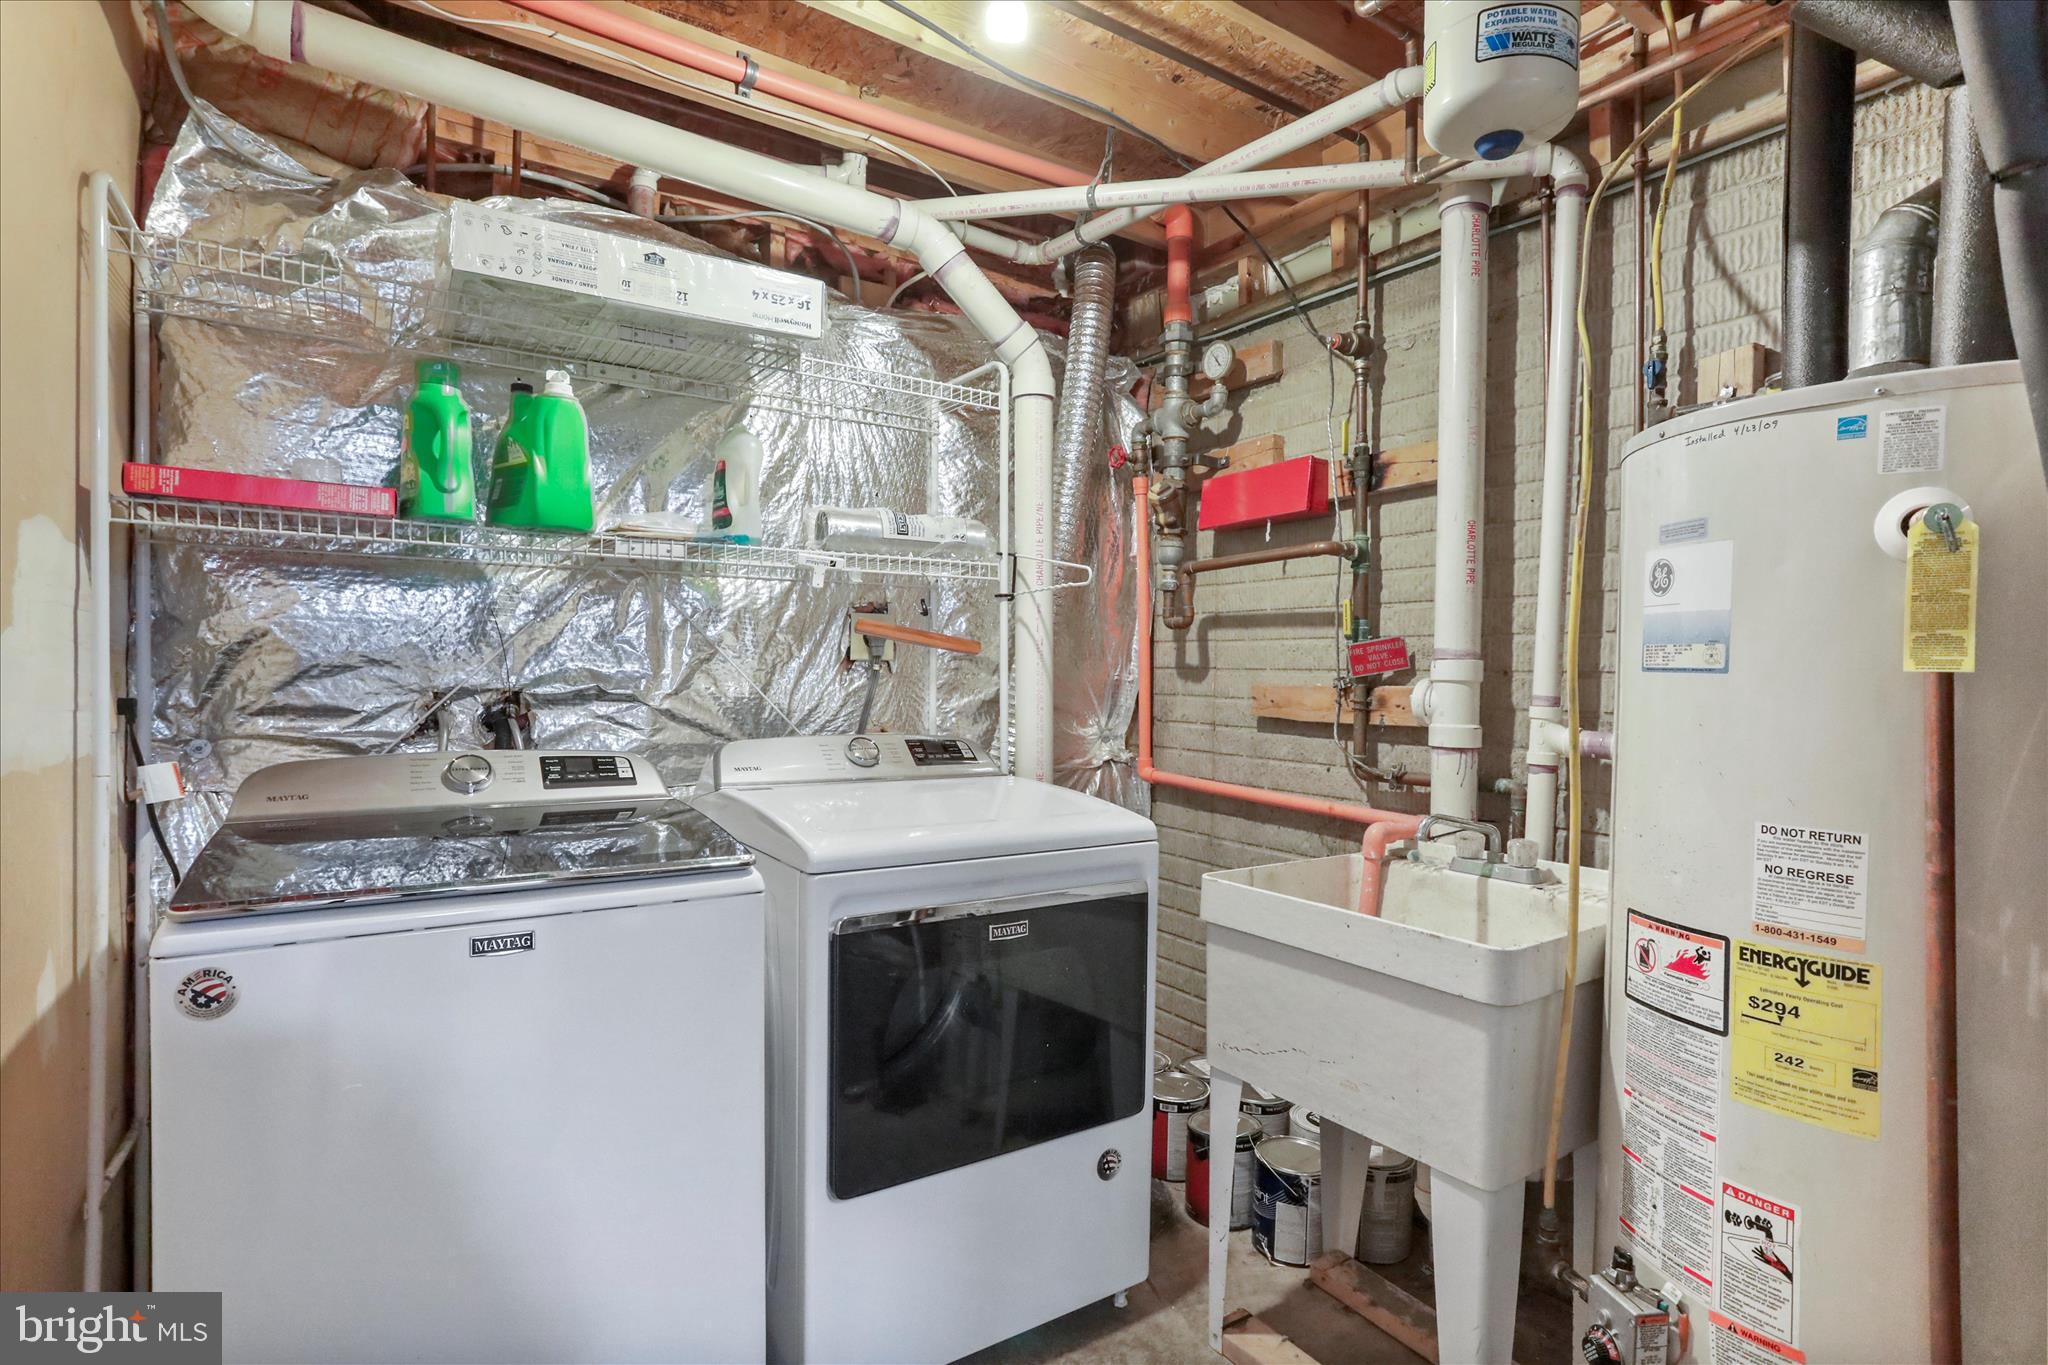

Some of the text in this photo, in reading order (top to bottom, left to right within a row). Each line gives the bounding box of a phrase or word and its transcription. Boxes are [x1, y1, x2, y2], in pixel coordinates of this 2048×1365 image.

[1485, 16, 1558, 28] EXPANSION TANK
[1487, 7, 1558, 20] POTABLE WATER
[1512, 32, 1556, 44] WATTS
[1512, 42, 1555, 50] REGULATOR
[1471, 214, 1480, 278] CHARLOTTE PIPE
[772, 294, 786, 306] 25
[774, 316, 812, 330] Honeywell
[1685, 420, 1778, 446] Installed 4/23/09
[1466, 520, 1476, 584] CHARLOTTE PIPE
[1354, 658, 1405, 672] DO NOT CLOSE
[266, 794, 310, 803] MAYTAG
[1761, 824, 1862, 845] DO NOT RETURN
[1764, 864, 1855, 886] NO REGRESE
[993, 924, 1026, 937] MAYTAG
[1755, 924, 1837, 946] 1-800-431-1549
[475, 936, 530, 952] MAYTAG
[1739, 946, 1870, 985] ENERGYGUIDE
[178, 969, 233, 996] AMERICA
[1748, 995, 1800, 1019] $294
[1774, 1052, 1804, 1068] 242
[1738, 1191, 1790, 1218] DANGER
[1740, 1328, 1781, 1353] WARNING
